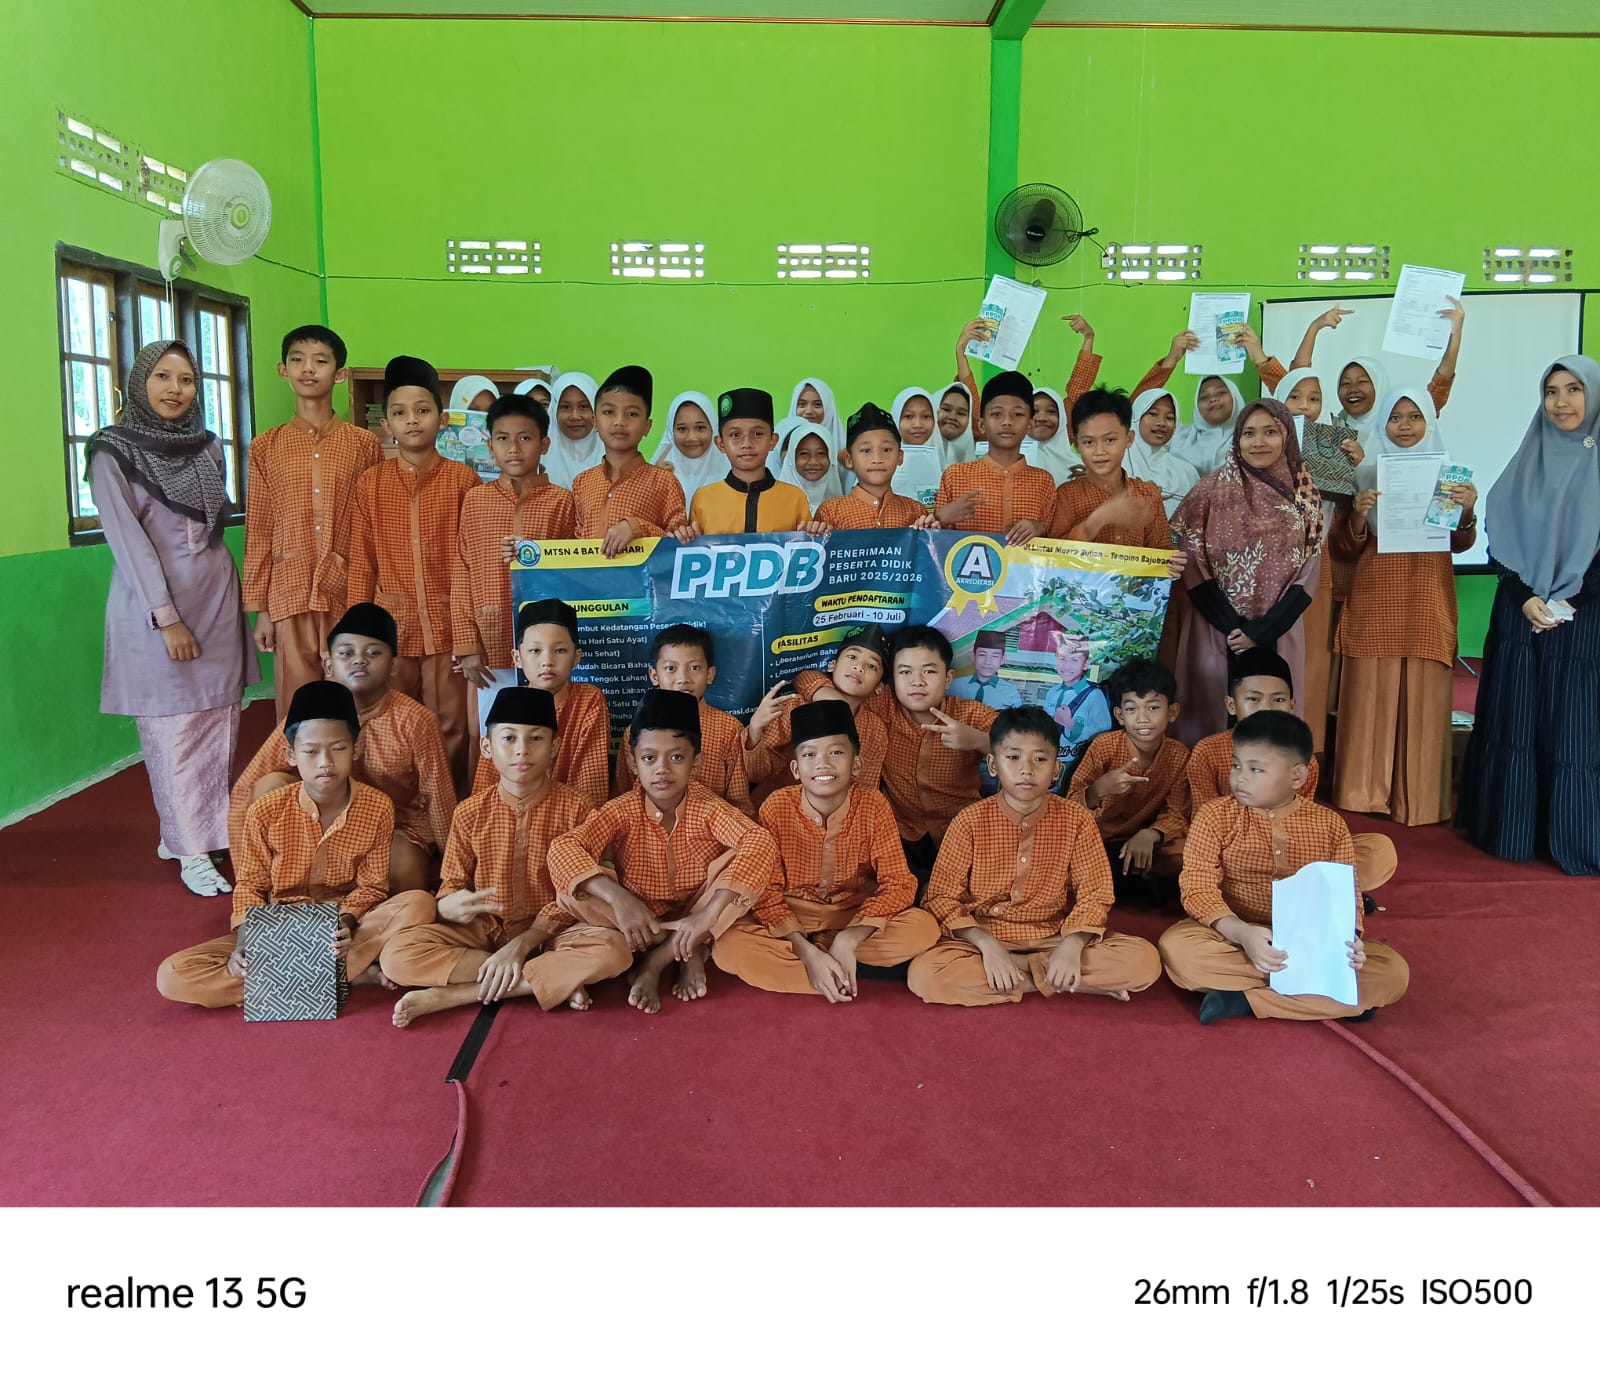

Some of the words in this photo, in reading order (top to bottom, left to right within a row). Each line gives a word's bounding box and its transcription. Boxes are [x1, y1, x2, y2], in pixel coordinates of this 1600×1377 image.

[544, 548, 571, 556] MTSN
[573, 547, 579, 555] 4
[830, 547, 902, 559] PENERIMAAN
[829, 560, 877, 571] PESERTA
[881, 560, 912, 569] DIDIK
[957, 543, 994, 580] A
[670, 541, 826, 599] PPDB
[829, 573, 857, 585] BARU
[860, 571, 922, 583] 2025/2026
[956, 577, 994, 586] AKREDITASI
[821, 597, 847, 608] WAKTU
[847, 594, 906, 605] PENDAFTARAN
[573, 603, 629, 613] UNGGULAN
[815, 615, 827, 625] 25
[828, 610, 865, 622] Februari
[872, 611, 884, 620] 10
[886, 611, 902, 621] Juli
[600, 623, 649, 632] Kedatangan
[588, 637, 605, 645] Hari
[606, 636, 625, 644] Satu
[626, 635, 648, 645] Ayat)
[777, 635, 819, 649] FASILITAS
[594, 650, 620, 658] Sehat)
[601, 662, 626, 670] Bicara
[590, 675, 619, 684] Tengok
[621, 674, 648, 682] Lahan)
[621, 687, 646, 695] Lahan
